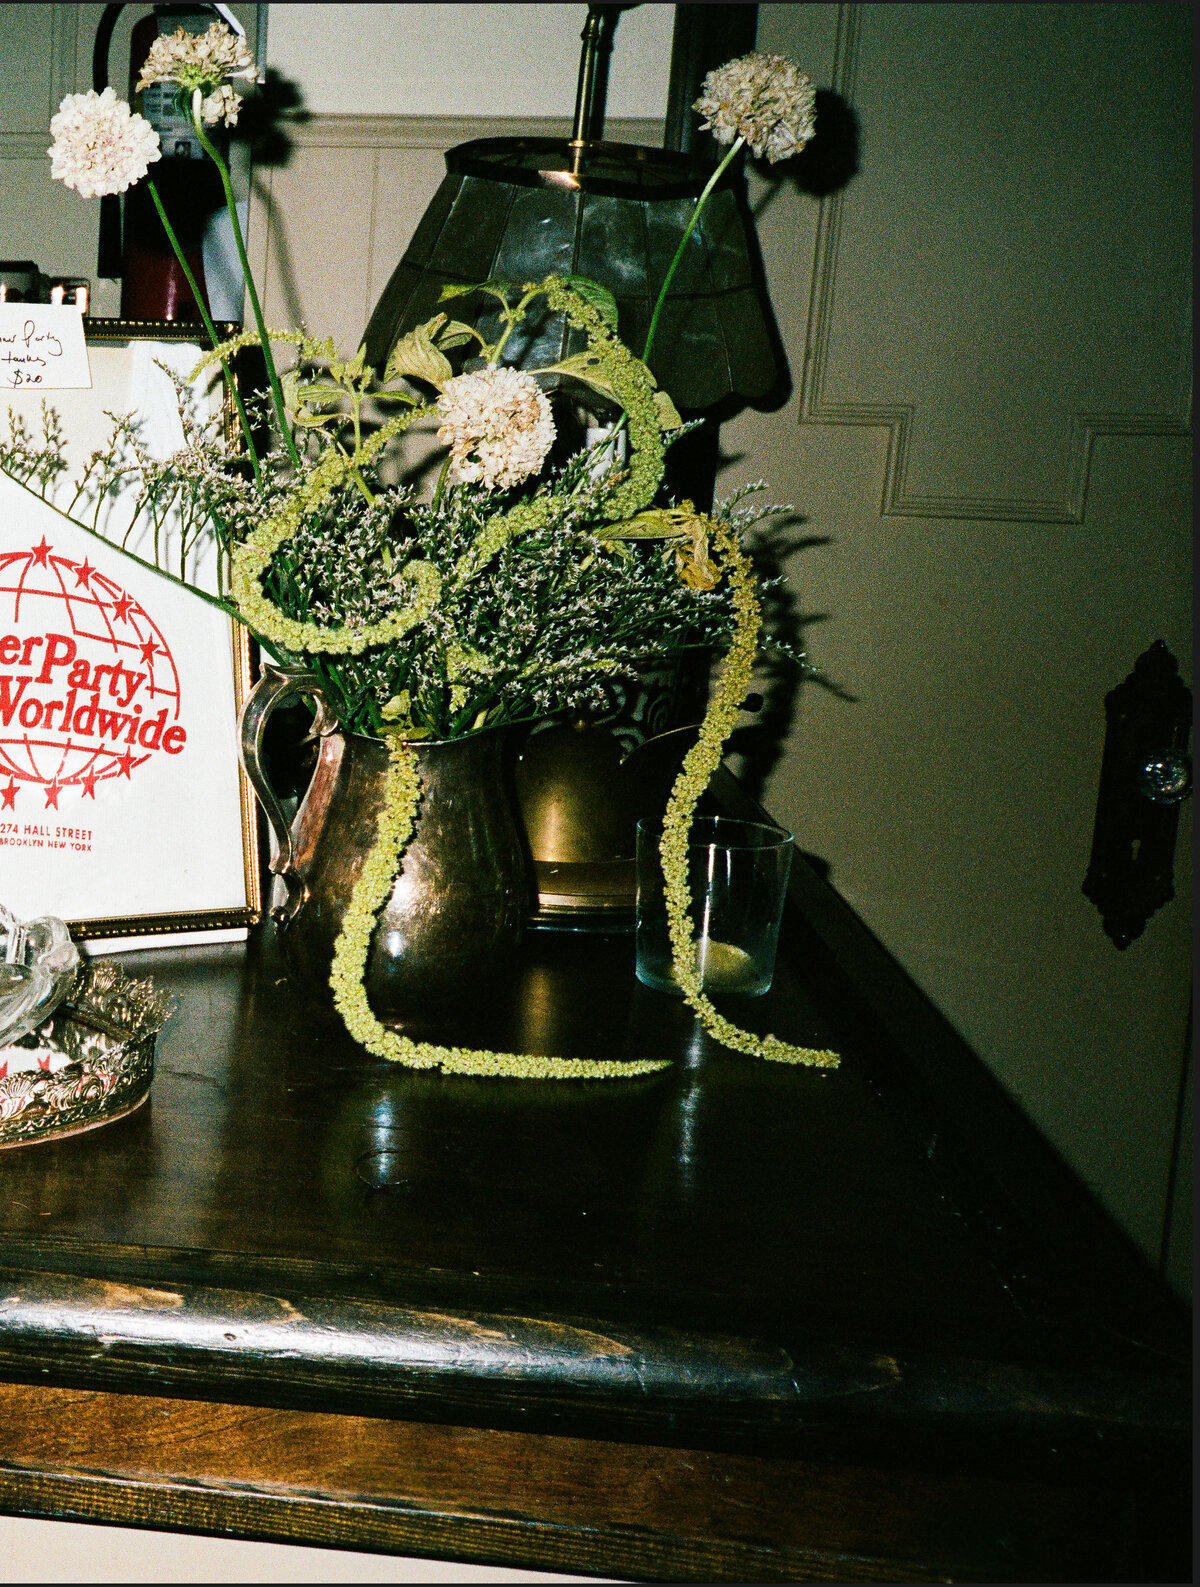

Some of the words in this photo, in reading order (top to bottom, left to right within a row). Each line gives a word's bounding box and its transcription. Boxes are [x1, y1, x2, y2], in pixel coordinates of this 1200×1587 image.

[21, 319, 63, 357] Party
[6, 368, 43, 389] $20
[0, 823, 20, 835] 274
[23, 824, 50, 837] HALL
[55, 826, 93, 841] STREET
[0, 837, 44, 849] BROOKLYN
[47, 840, 67, 850] NEW
[70, 841, 92, 852] YORK
